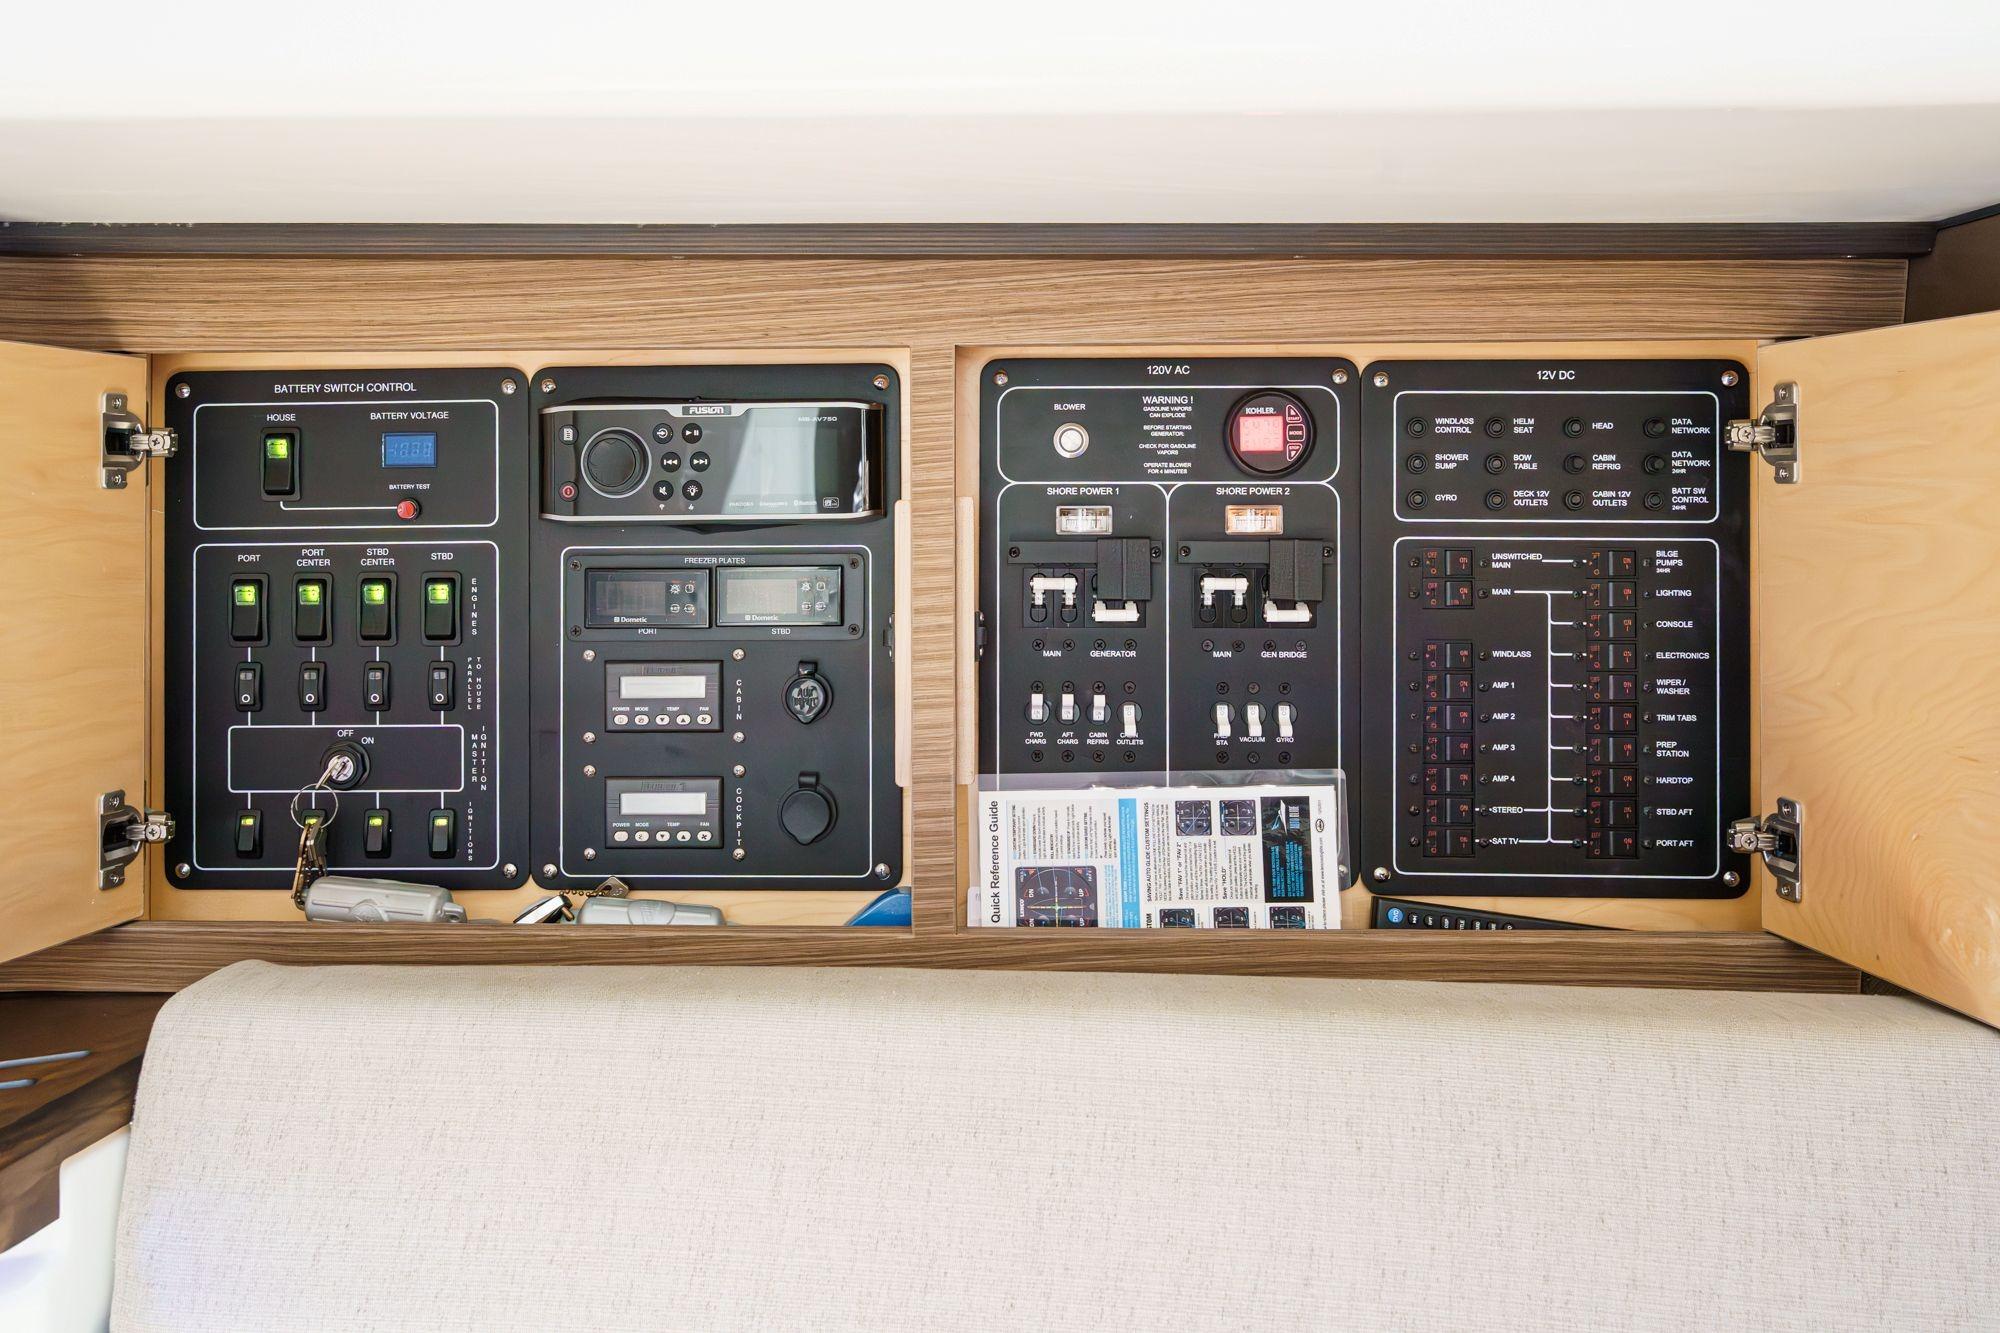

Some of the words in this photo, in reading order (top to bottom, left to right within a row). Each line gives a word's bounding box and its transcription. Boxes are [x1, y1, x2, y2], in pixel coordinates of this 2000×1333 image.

[1147, 366, 1172, 374] 120V
[1175, 366, 1190, 374] AC
[1537, 371, 1556, 379] 12V
[1559, 371, 1575, 379] DC
[275, 384, 321, 393] BATTERY
[324, 384, 363, 392] SWITCH
[367, 383, 416, 392] CONTROL
[1143, 396, 1188, 404] WARNING
[1190, 396, 1194, 404] !
[371, 412, 408, 420] BATTERY
[1047, 487, 1077, 495] SHORE
[1080, 487, 1113, 495] POWER
[1216, 487, 1247, 495] SHORE
[1250, 487, 1282, 495] POWER
[361, 558, 394, 566] CENTER
[476, 657, 481, 669] TO
[988, 800, 999, 832] Guide
[989, 835, 1000, 889] Reference
[990, 891, 1001, 923] Quick
